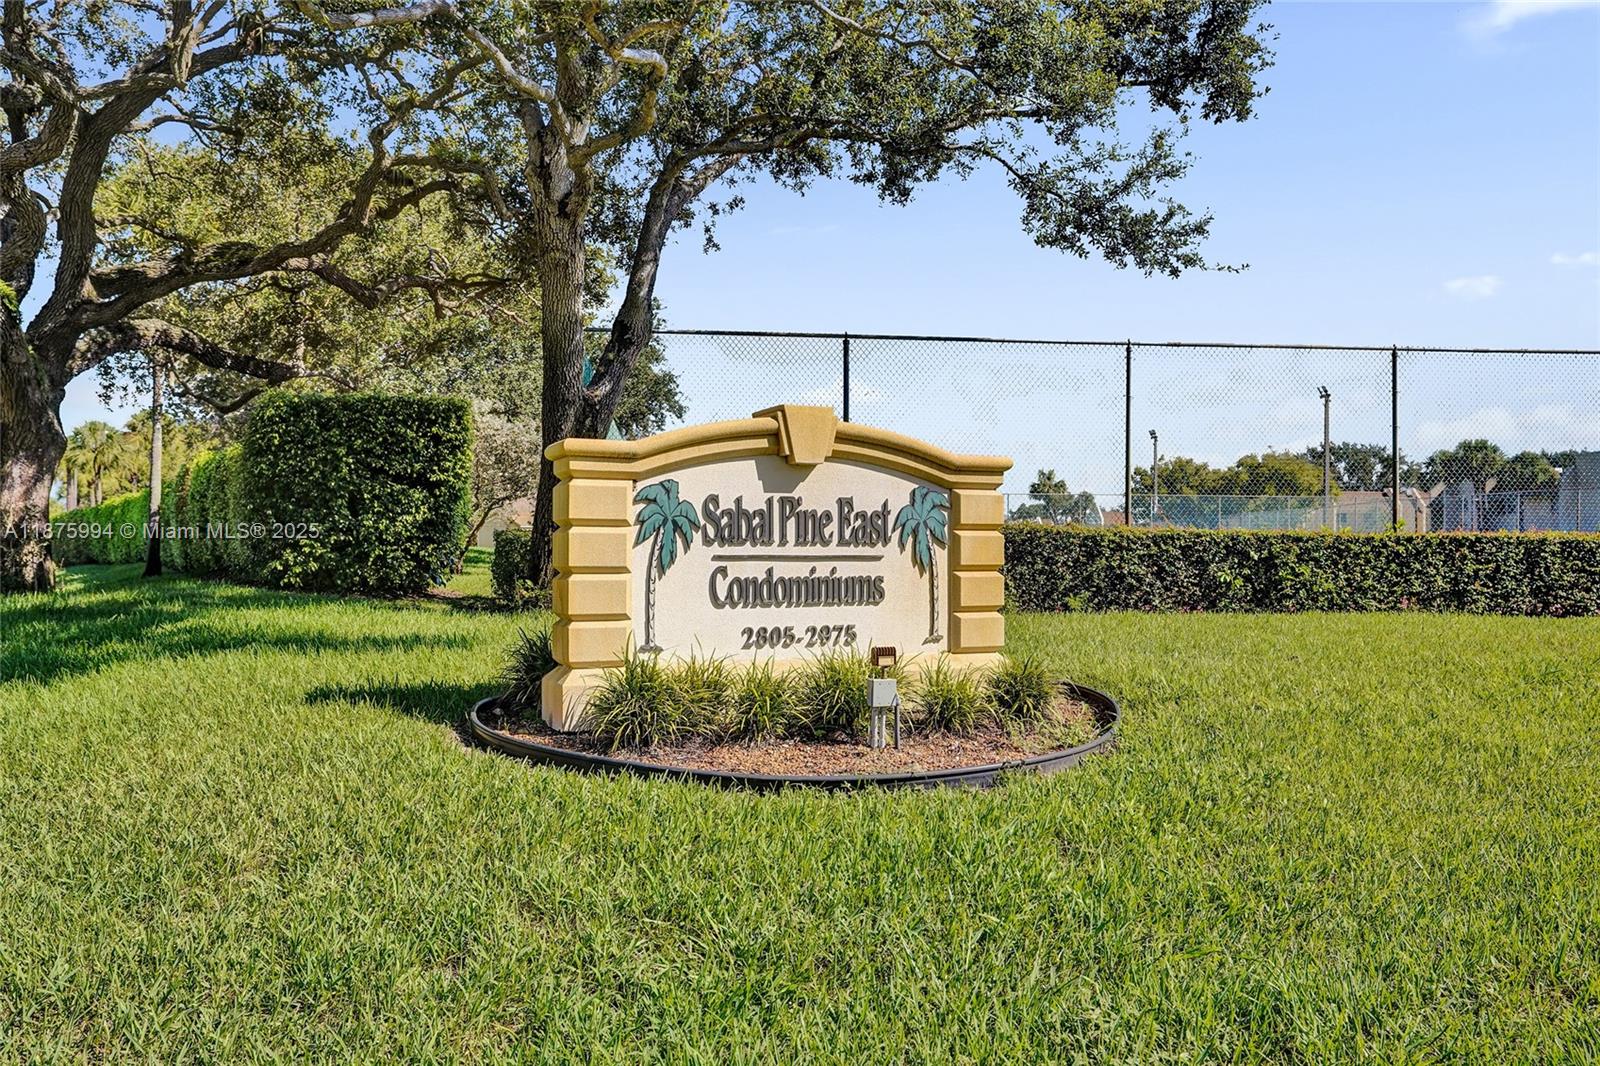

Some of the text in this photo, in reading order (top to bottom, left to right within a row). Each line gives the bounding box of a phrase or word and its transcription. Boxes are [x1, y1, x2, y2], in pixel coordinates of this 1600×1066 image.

[702, 494, 891, 548] Sabal Pine East
[709, 566, 885, 609] Condominiums
[741, 624, 857, 650] 2805-2975
